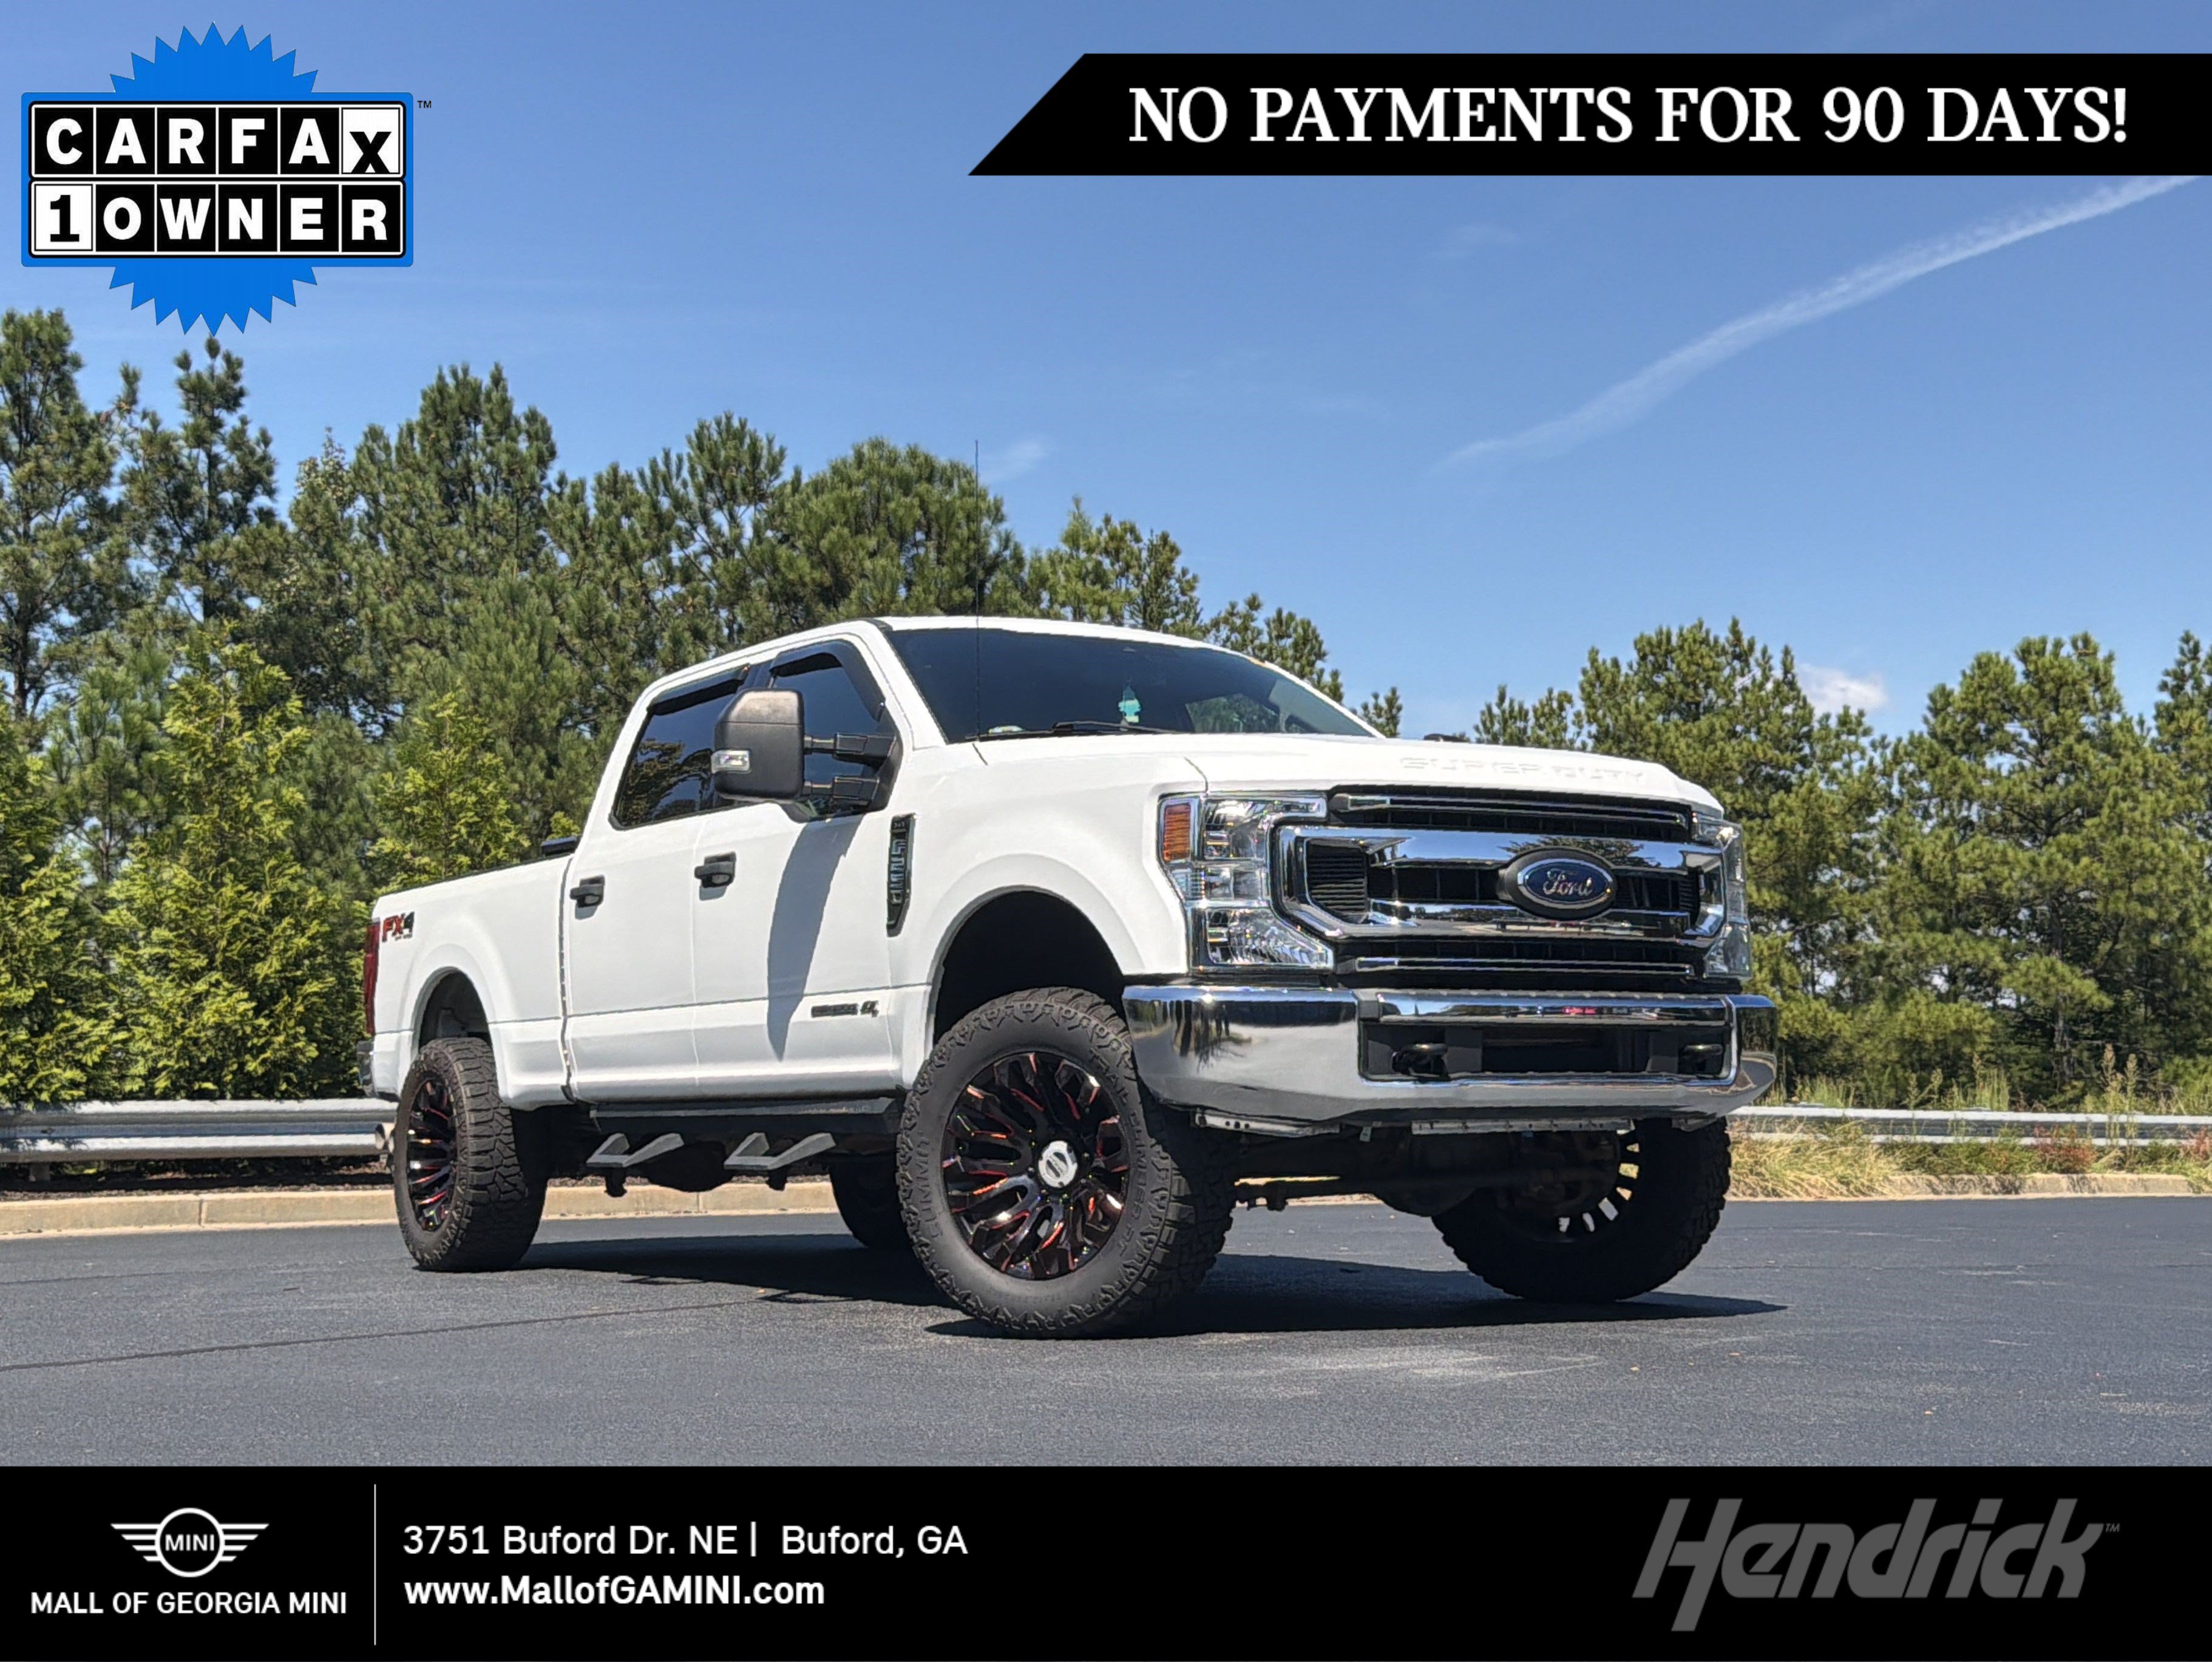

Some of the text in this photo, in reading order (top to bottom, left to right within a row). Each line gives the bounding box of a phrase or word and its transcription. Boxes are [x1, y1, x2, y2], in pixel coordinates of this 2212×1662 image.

[1400, 757, 1541, 774] SUPER
[1542, 867, 1593, 898] Ford
[382, 911, 415, 942] FX4
